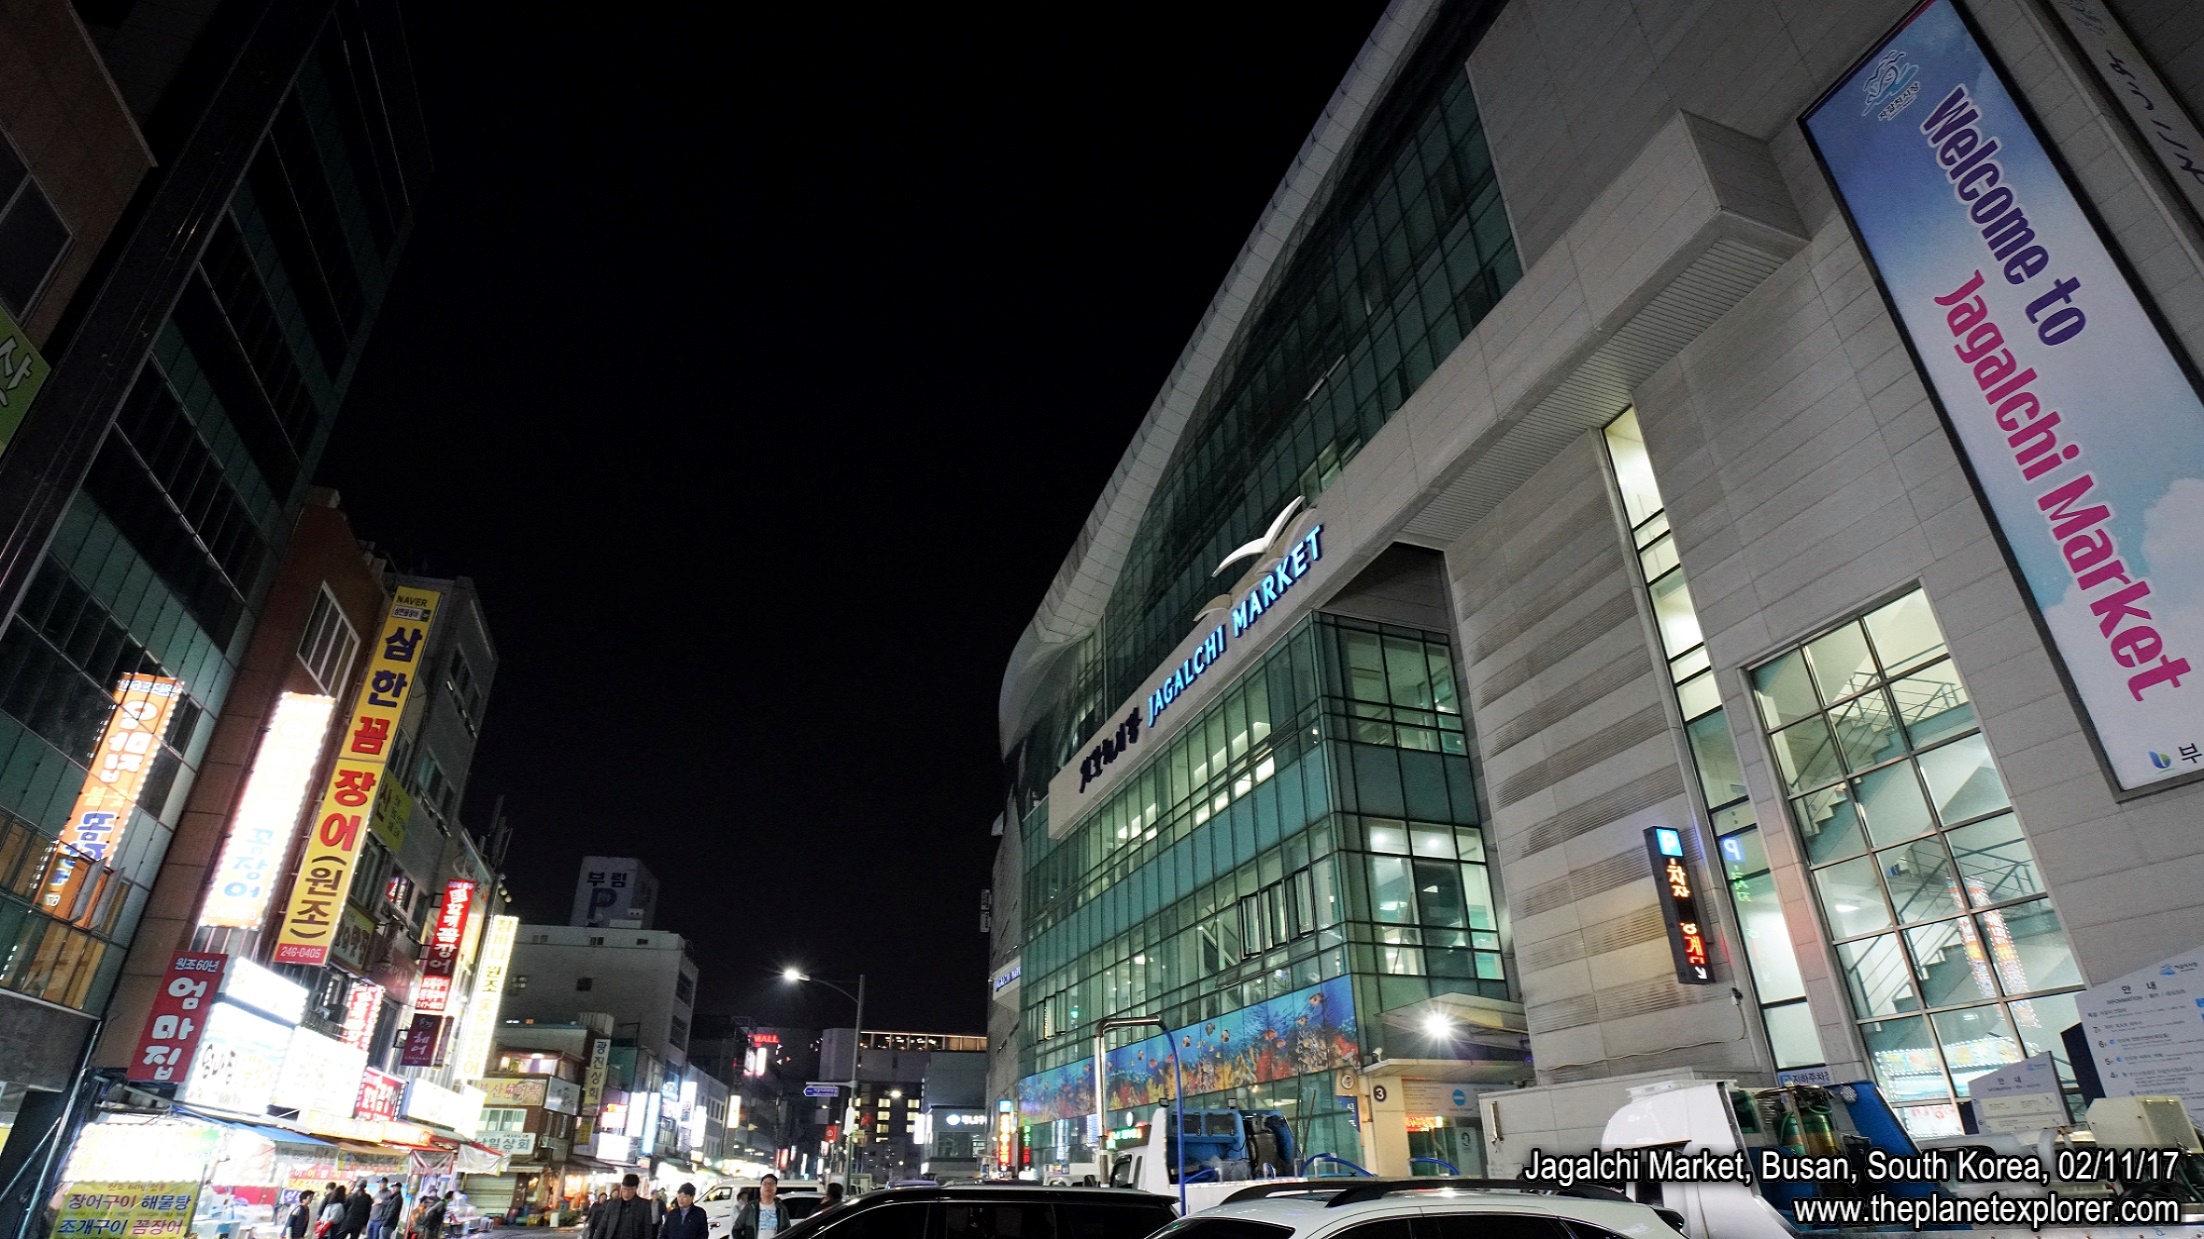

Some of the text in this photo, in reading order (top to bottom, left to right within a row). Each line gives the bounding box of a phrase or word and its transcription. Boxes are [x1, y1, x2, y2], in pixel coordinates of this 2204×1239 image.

[1924, 86, 2086, 346] Welcome to
[1934, 269, 2191, 702] Jagalchi Market
[396, 595, 428, 607] NAVER
[1147, 525, 1324, 728] JAGALCHI MARKET
[1661, 832, 1677, 855] P
[586, 872, 628, 888] 부림
[280, 946, 322, 960] 246-0405
[175, 957, 220, 973] 원조60년
[2121, 981, 2157, 995] 안 내
[142, 976, 208, 1081] 엄마집
[1376, 1087, 1384, 1099] 3
[69, 1194, 191, 1210] 장어구이 해물탕
[57, 1219, 183, 1235] 조개구이 꼼장어
